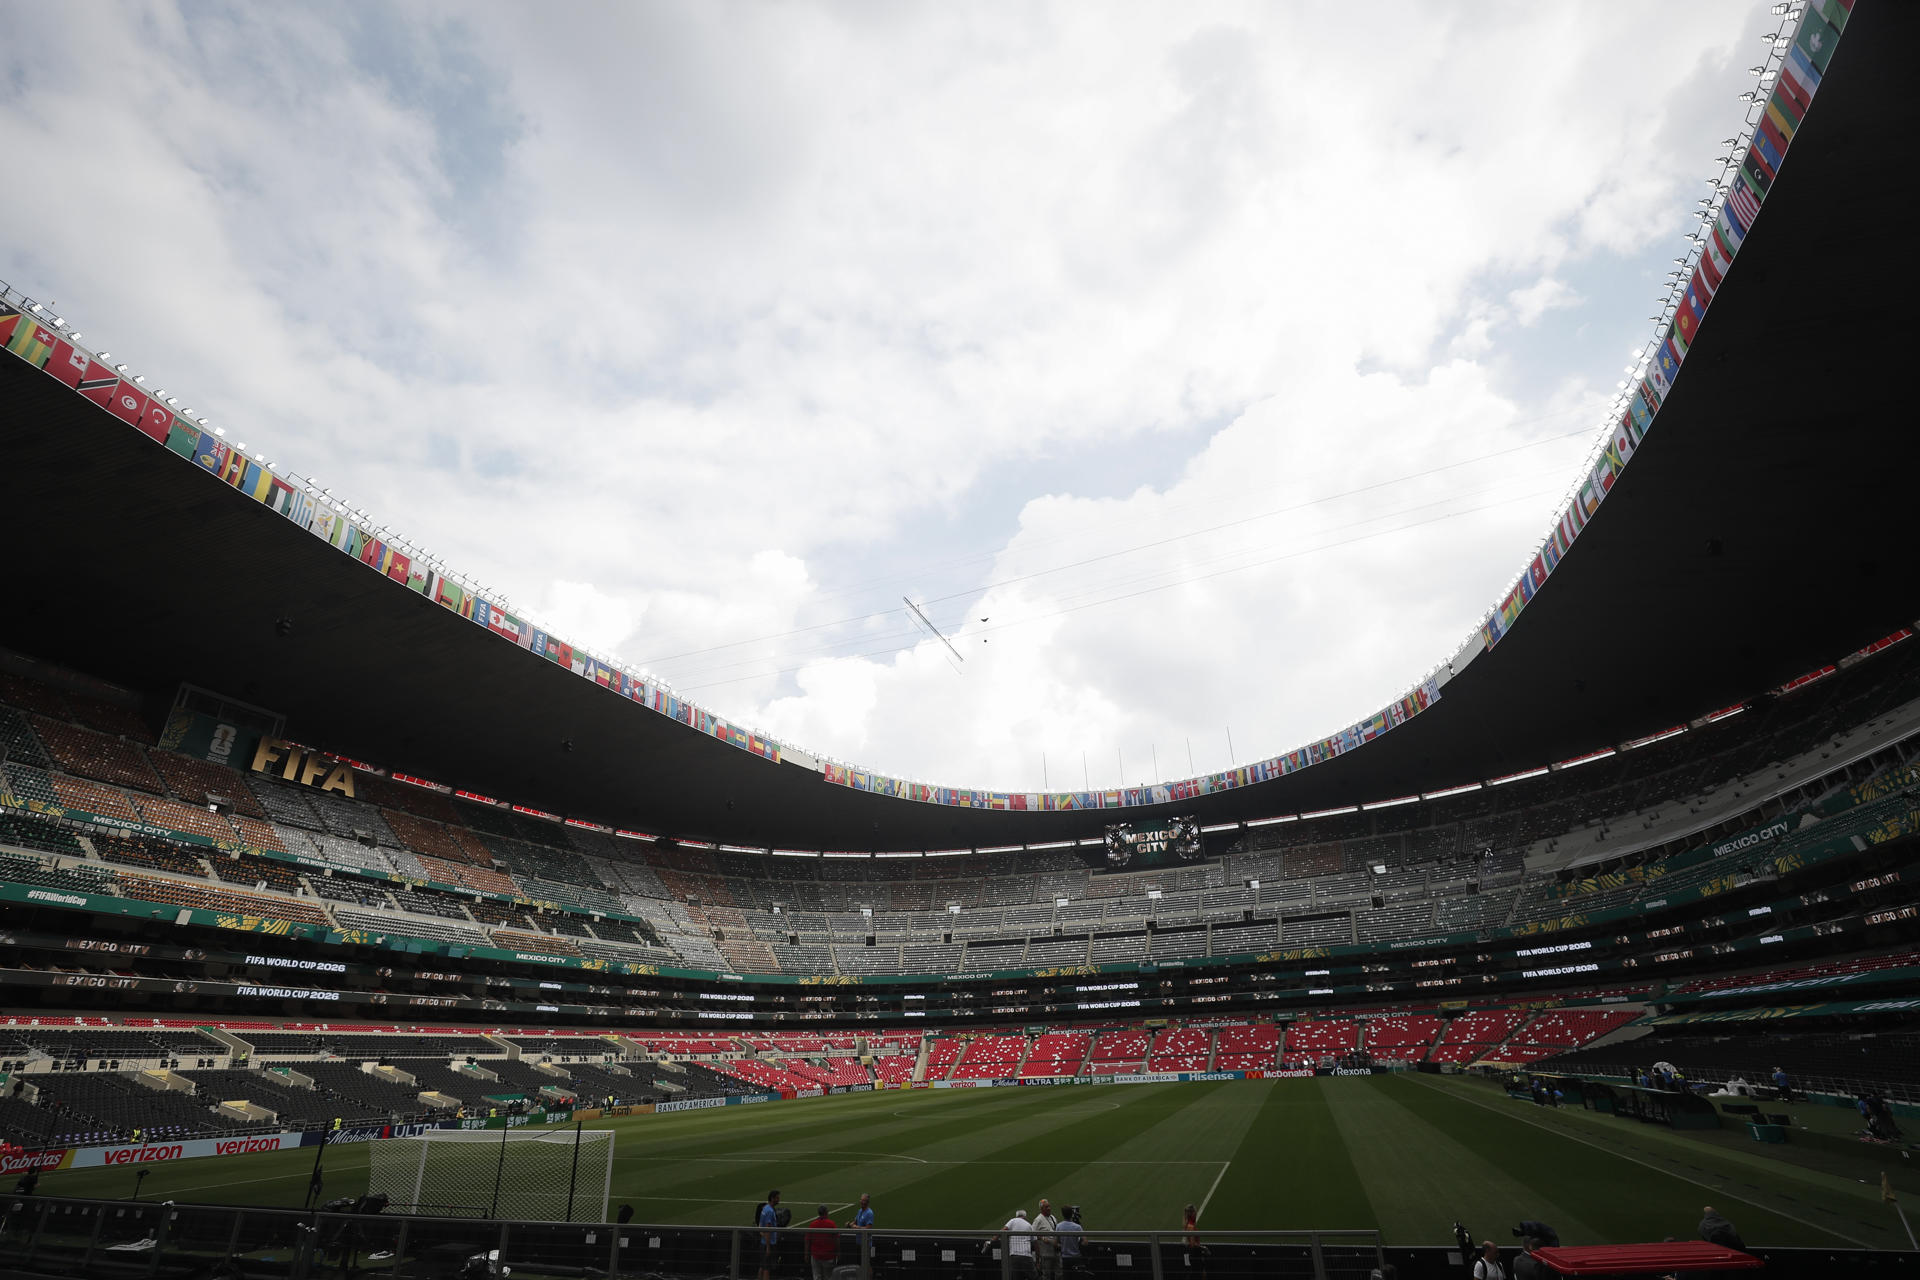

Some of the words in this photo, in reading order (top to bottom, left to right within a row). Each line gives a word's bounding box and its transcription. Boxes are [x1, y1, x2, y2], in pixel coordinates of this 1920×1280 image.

[251, 735, 355, 799] FIFA
[93, 816, 142, 831] MEXICO
[144, 826, 172, 838] CITY
[1125, 829, 1178, 844] MEXICO
[1713, 833, 1759, 857] MEXICO
[1760, 821, 1788, 840] CITY
[1136, 841, 1168, 853] CITY
[27, 890, 87, 907] #FIFAWorldCup
[454, 887, 481, 896] MEXICO
[481, 891, 499, 899] CITY
[1391, 939, 1426, 949] MEXICO
[1531, 946, 1555, 955] WORLD
[1568, 941, 1592, 950] 2026
[245, 955, 267, 965] FIFA
[266, 958, 299, 968] WORLD
[299, 961, 316, 970] CUP
[316, 962, 346, 973] 2026
[516, 953, 547, 962] MEXICO
[1537, 968, 1561, 976] WORLD
[1561, 966, 1575, 974] CUP
[1575, 963, 1599, 972] 2026
[236, 987, 258, 997] FIFA
[258, 988, 292, 999] WORLD
[292, 990, 309, 999] CUP
[309, 992, 341, 1001] 2026
[1189, 1072, 1235, 1081] Hisense
[1263, 1070, 1313, 1078] McDonald's
[1337, 1068, 1372, 1076] Rexona
[950, 1080, 977, 1088] verizon
[1025, 1078, 1051, 1086] ULTRA
[658, 1103, 677, 1112] BANK
[679, 1102, 689, 1111] OF
[689, 1099, 717, 1110] AMERICA
[741, 1095, 768, 1104] Hisense
[326, 1127, 380, 1144] Michelob
[216, 1136, 280, 1155] verizon
[105, 1143, 183, 1164] verizon
